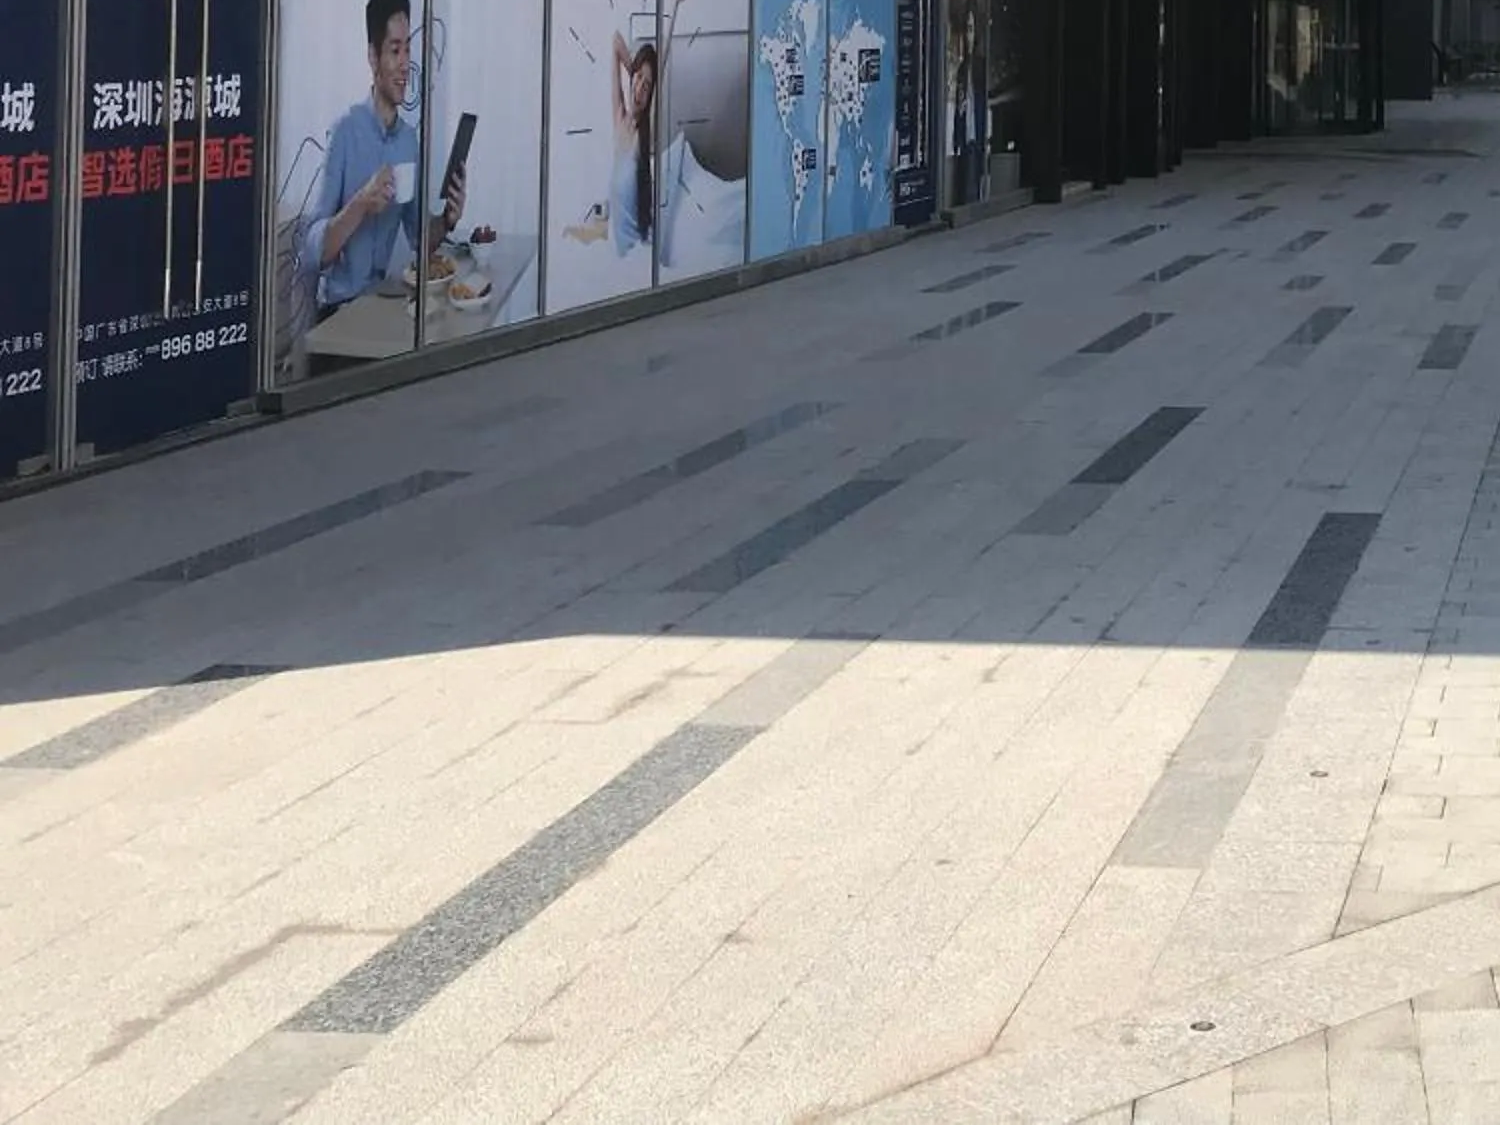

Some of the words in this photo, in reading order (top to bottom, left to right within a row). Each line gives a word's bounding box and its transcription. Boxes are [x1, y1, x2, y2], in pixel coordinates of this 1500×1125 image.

[161, 334, 192, 360] 896
[195, 329, 216, 352] 88
[218, 322, 248, 347] 222
[6, 368, 42, 396] 222
